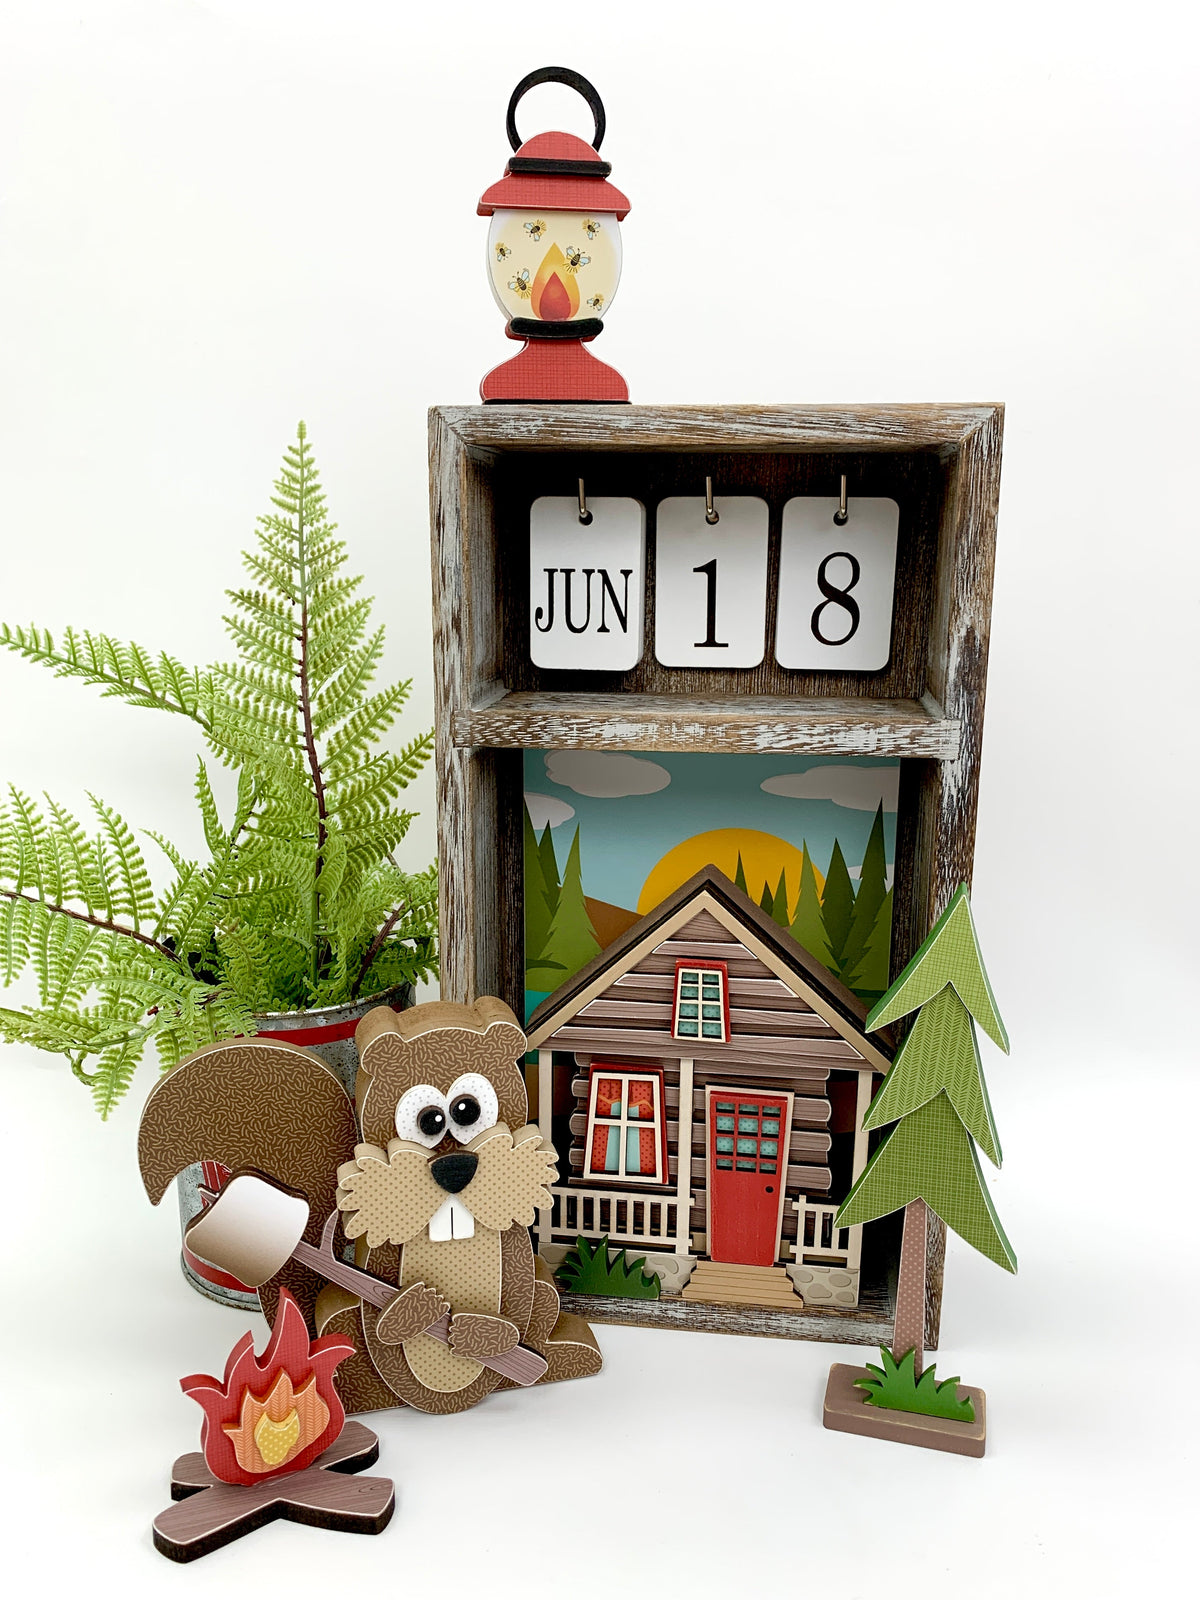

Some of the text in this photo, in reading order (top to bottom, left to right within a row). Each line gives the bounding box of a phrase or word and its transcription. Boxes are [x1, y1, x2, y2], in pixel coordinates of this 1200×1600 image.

[534, 551, 861, 648] JUN 1 8
